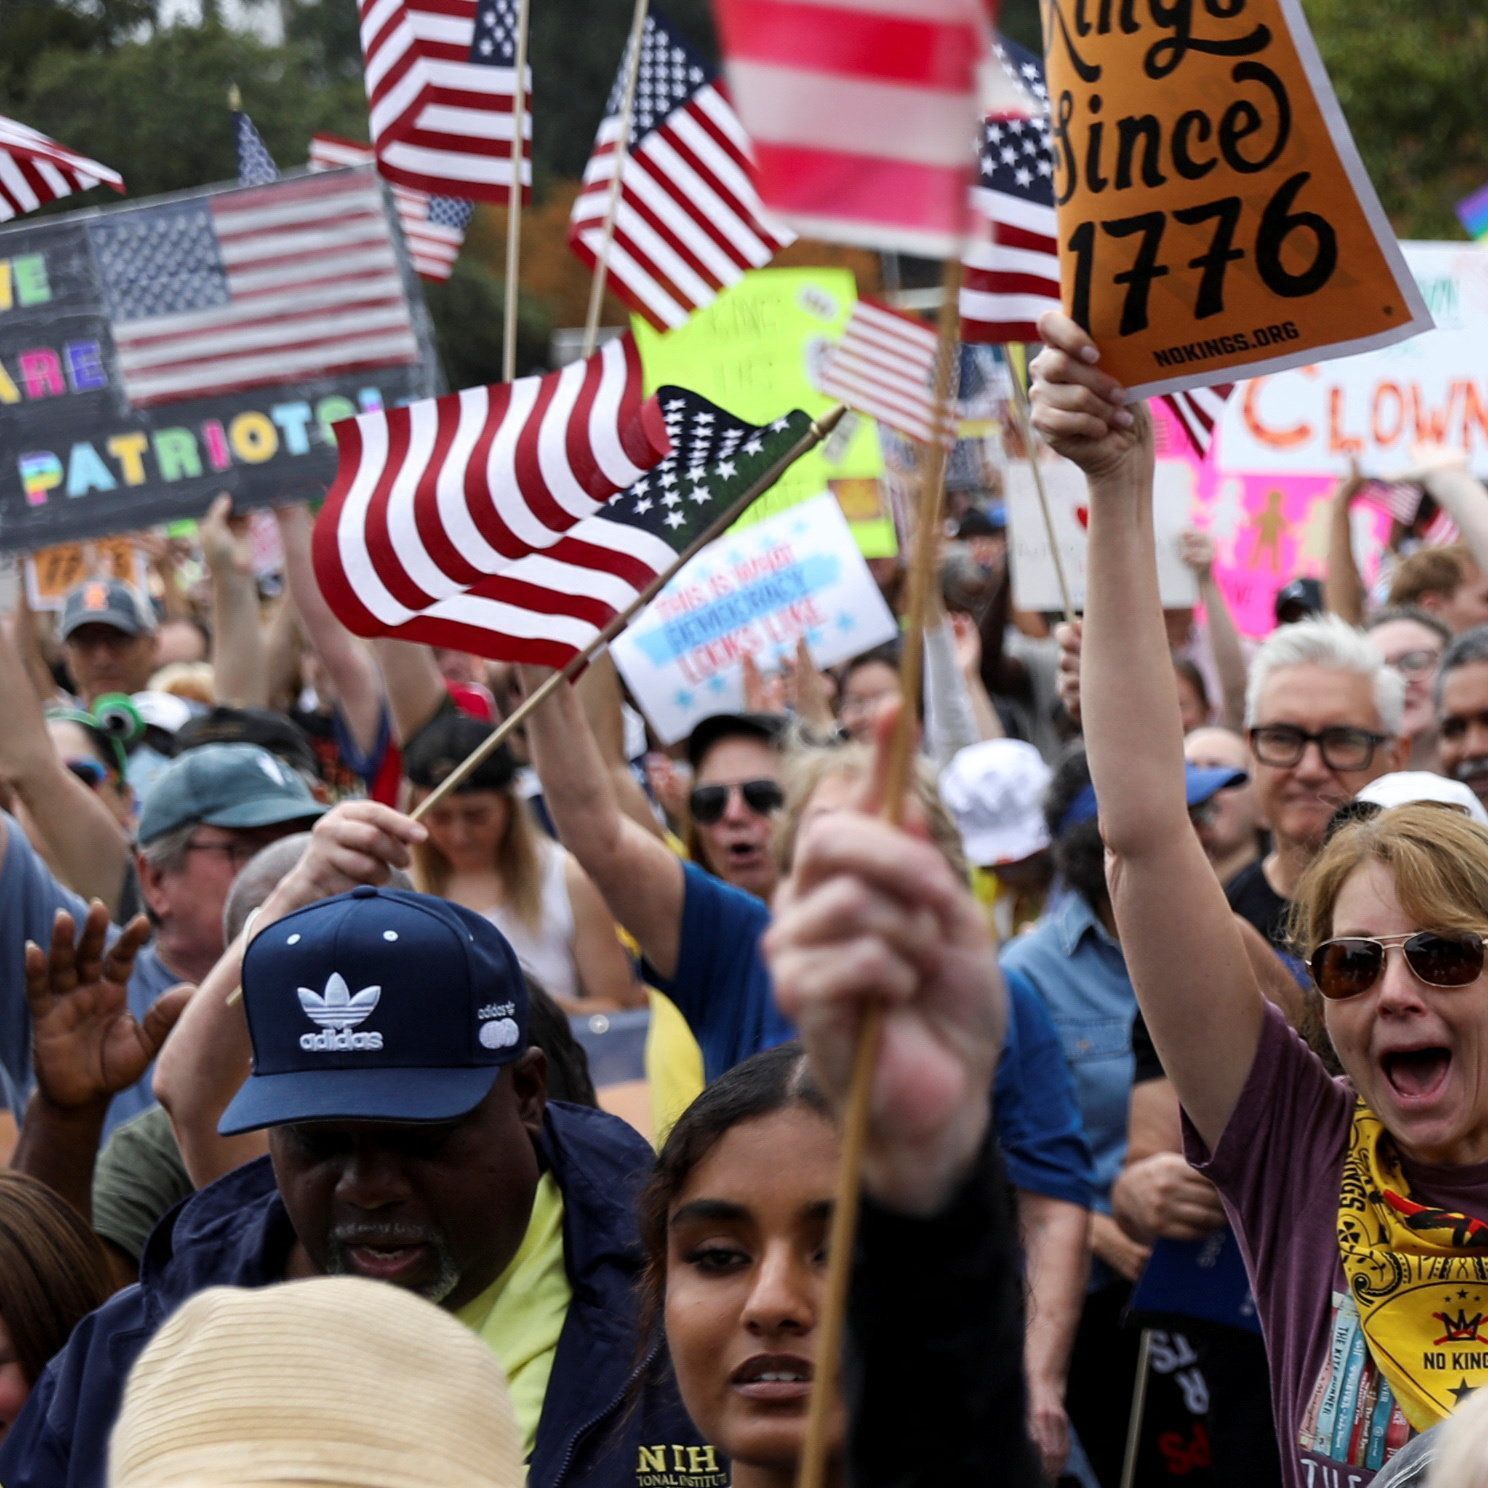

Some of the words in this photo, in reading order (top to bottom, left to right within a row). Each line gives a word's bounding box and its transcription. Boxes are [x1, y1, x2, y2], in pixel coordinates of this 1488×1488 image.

[1052, 61, 1291, 206] Since
[1068, 171, 1338, 338] 1776
[1152, 320, 1301, 368] NOKINGS.ORG
[298, 1027, 385, 1051] adidas
[1422, 1351, 1447, 1371] NO
[635, 1444, 720, 1473] NIH
